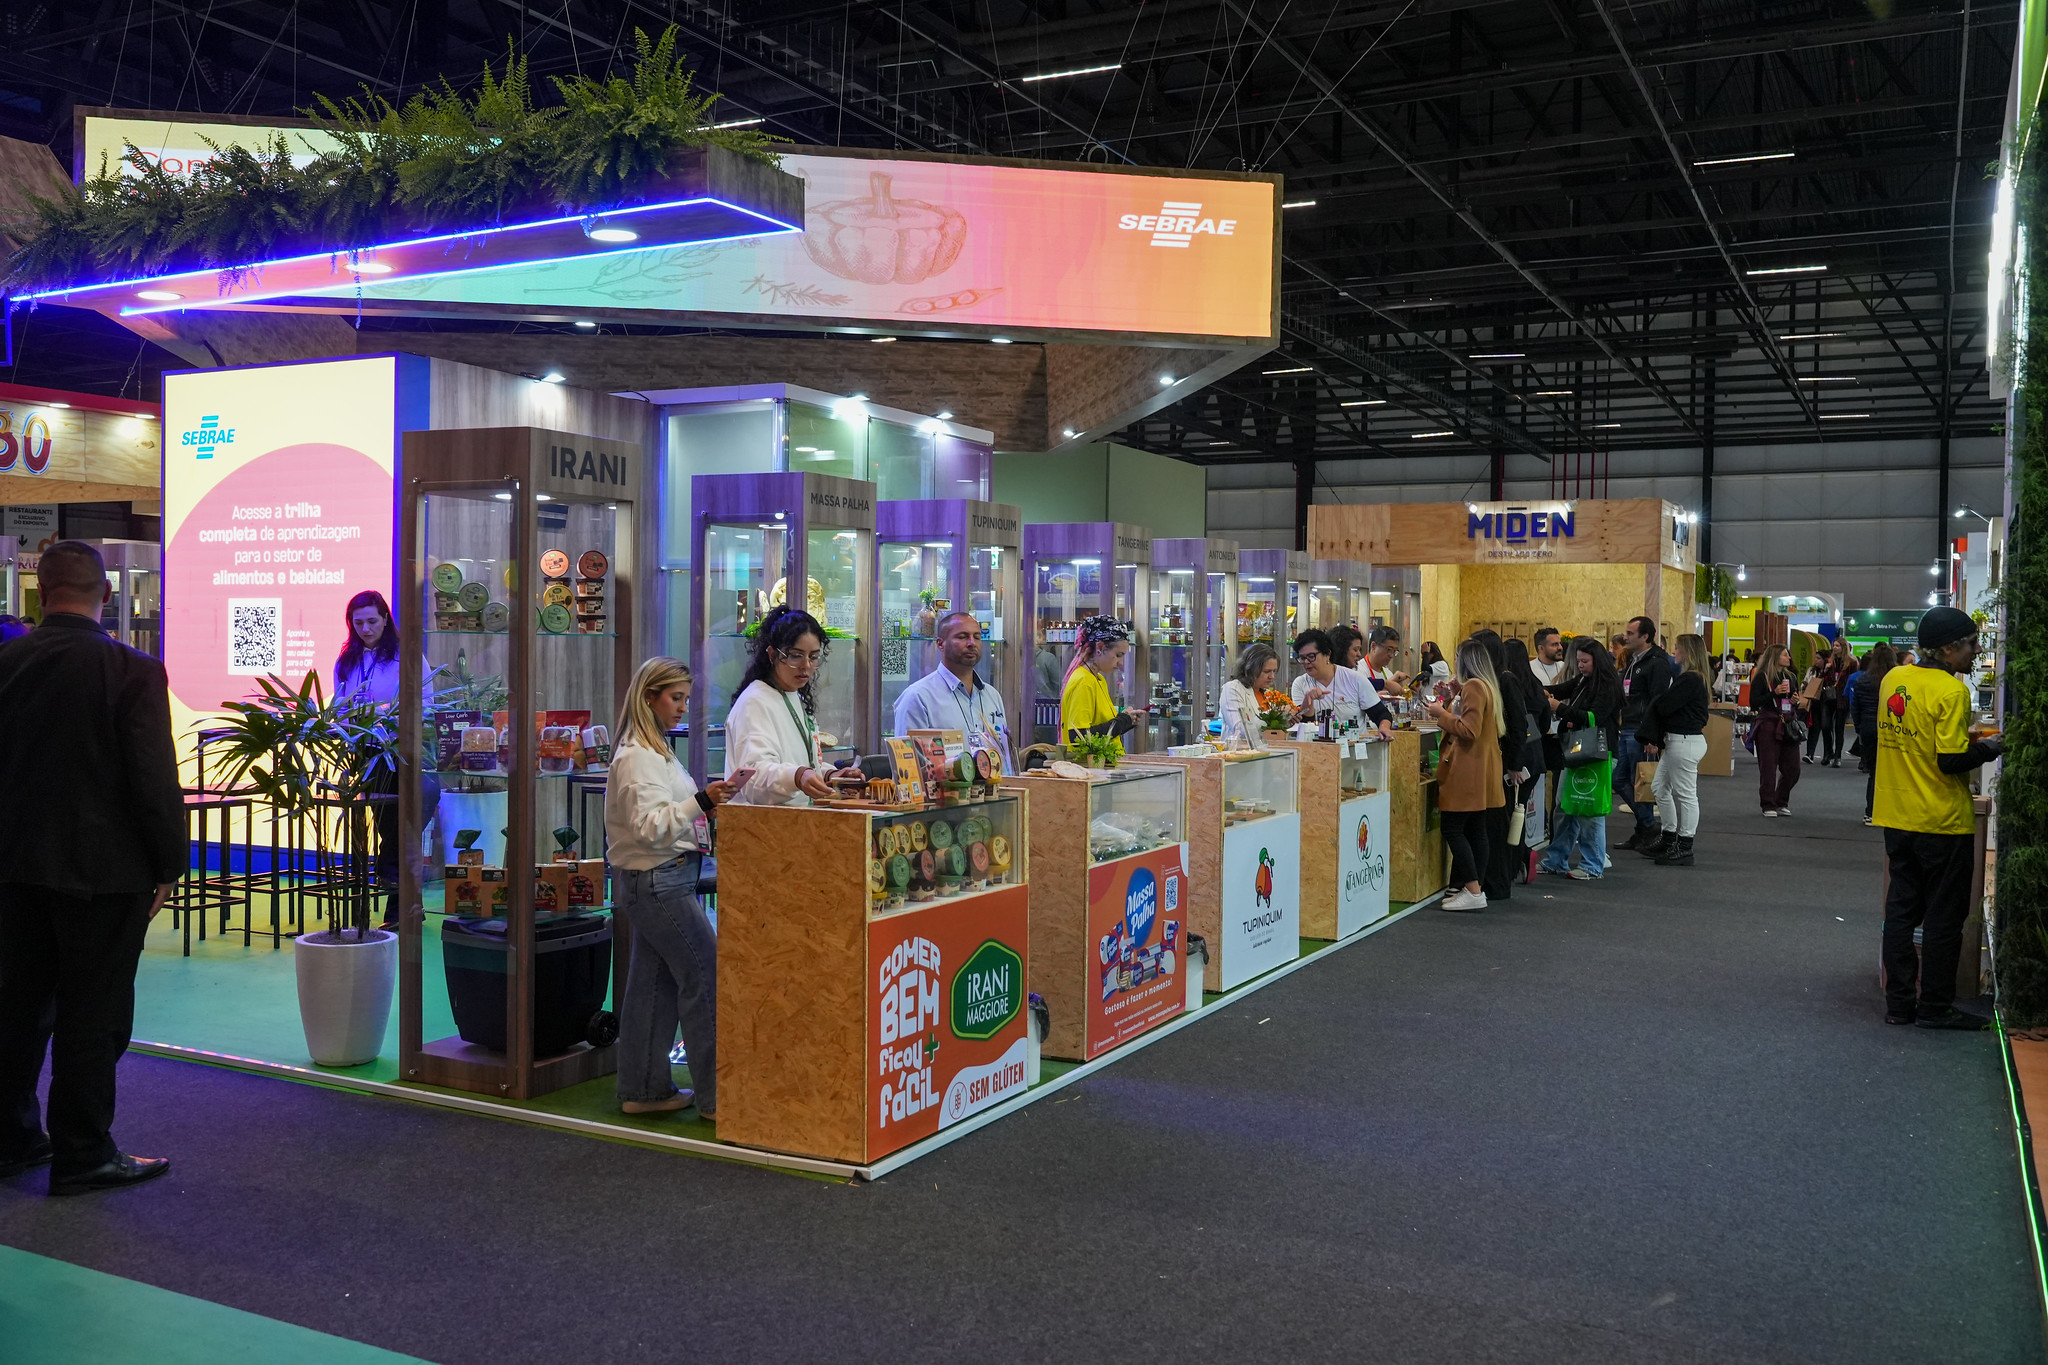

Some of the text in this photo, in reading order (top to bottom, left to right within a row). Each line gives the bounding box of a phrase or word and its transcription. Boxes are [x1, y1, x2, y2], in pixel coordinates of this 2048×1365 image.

[1118, 214, 1237, 236] SEBRAE
[181, 429, 236, 446] SEBRAE
[550, 445, 627, 486] IRANI
[8, 506, 53, 515] RESTAURANTE
[231, 502, 321, 520] Acesse a trilha
[810, 492, 870, 512] MASSA PALHA
[199, 524, 361, 544] completa de aprendizagem
[972, 514, 1017, 532] TUPINIQUIM
[1468, 510, 1575, 540] MIDEN
[1117, 535, 1149, 551] TANGERINE
[1208, 545, 1236, 562] ANTONIETA
[1532, 550, 1553, 558] ZERO
[234, 546, 322, 565] para o setor de
[212, 568, 345, 585] alimentos e bebidas!
[1346, 858, 1384, 896] TANGERINE
[1126, 881, 1154, 917] Massa
[1131, 900, 1155, 936] Palha
[1242, 908, 1283, 934] TUPINIQUIM
[880, 936, 941, 994] COMER
[880, 969, 940, 1046] BEM
[1104, 1000, 1126, 1015] Gostoso
[1130, 991, 1144, 1003] fazer
[1148, 977, 1173, 995] momento!
[966, 996, 1009, 1027] MAGGIORE
[879, 1038, 923, 1076] ficou
[969, 1061, 1024, 1104] SEM GLÚTEN
